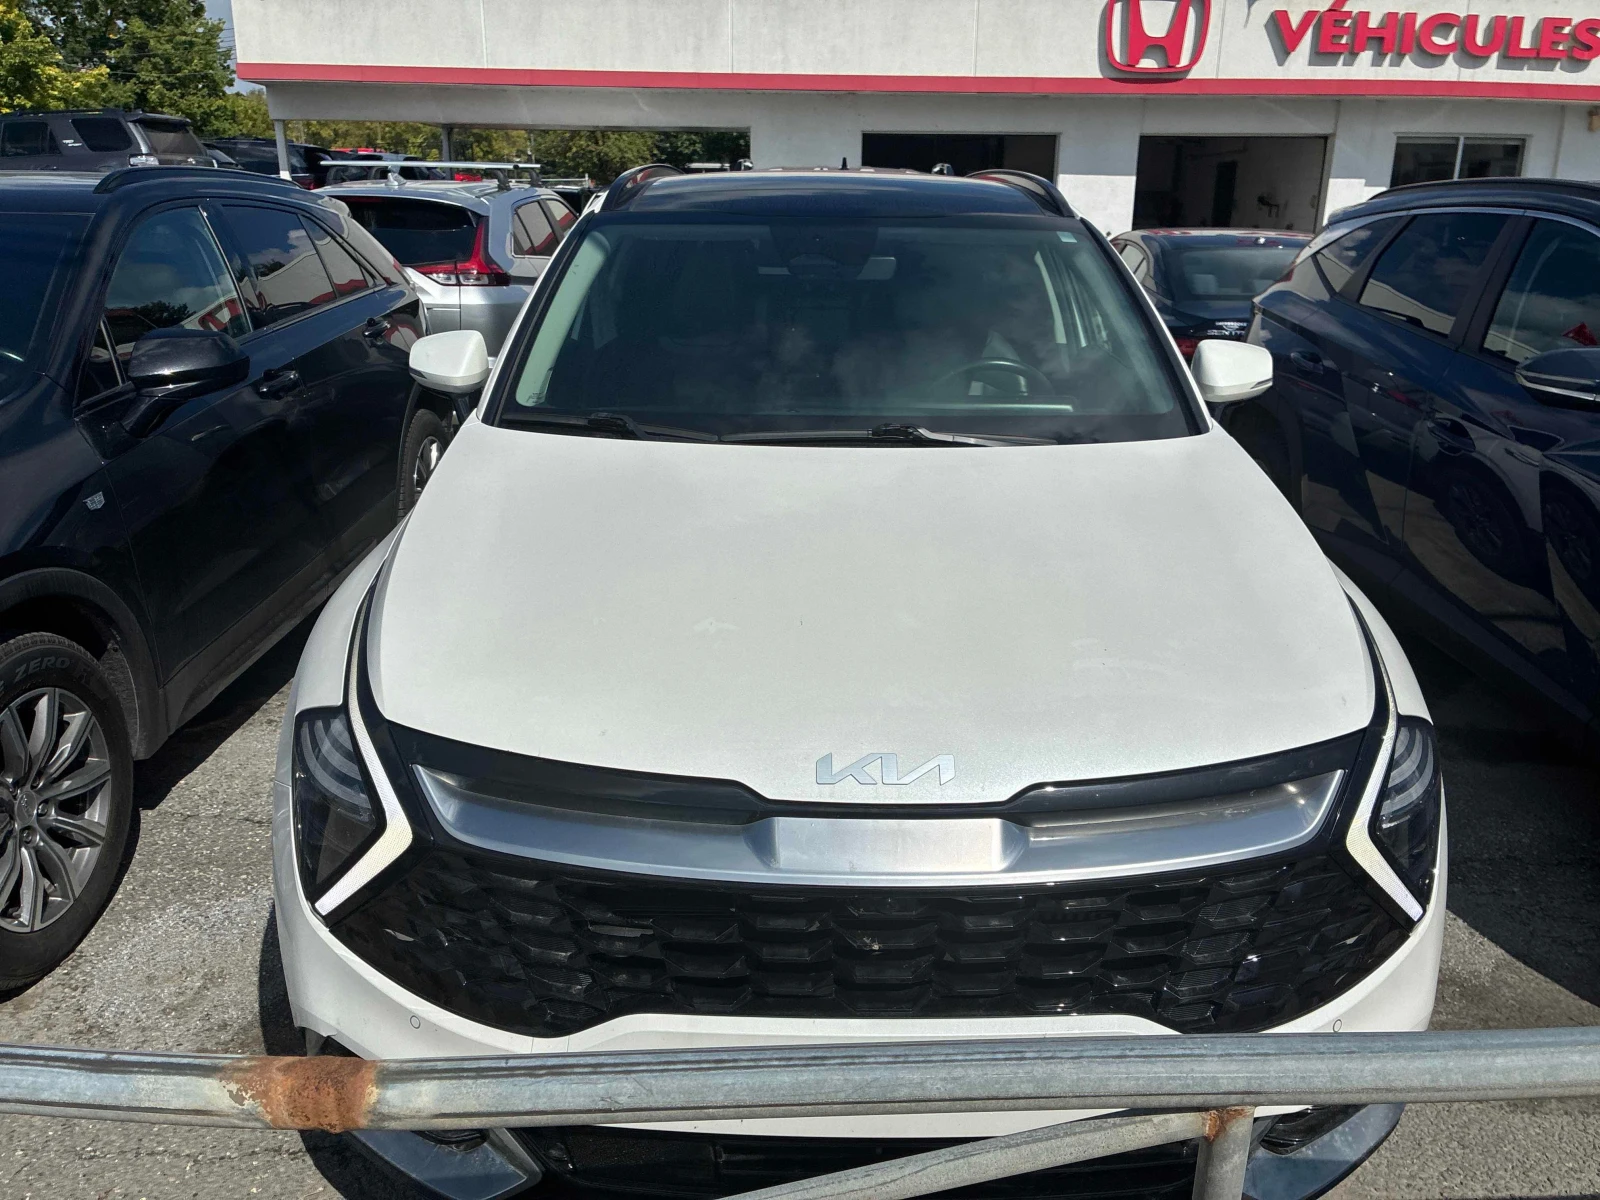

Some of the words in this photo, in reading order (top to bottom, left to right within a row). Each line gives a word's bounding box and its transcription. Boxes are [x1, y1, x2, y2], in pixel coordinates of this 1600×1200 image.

[1274, 0, 1600, 61] VÉHICULES
[14, 656, 71, 683] ZERO
[816, 752, 956, 786] KIA
